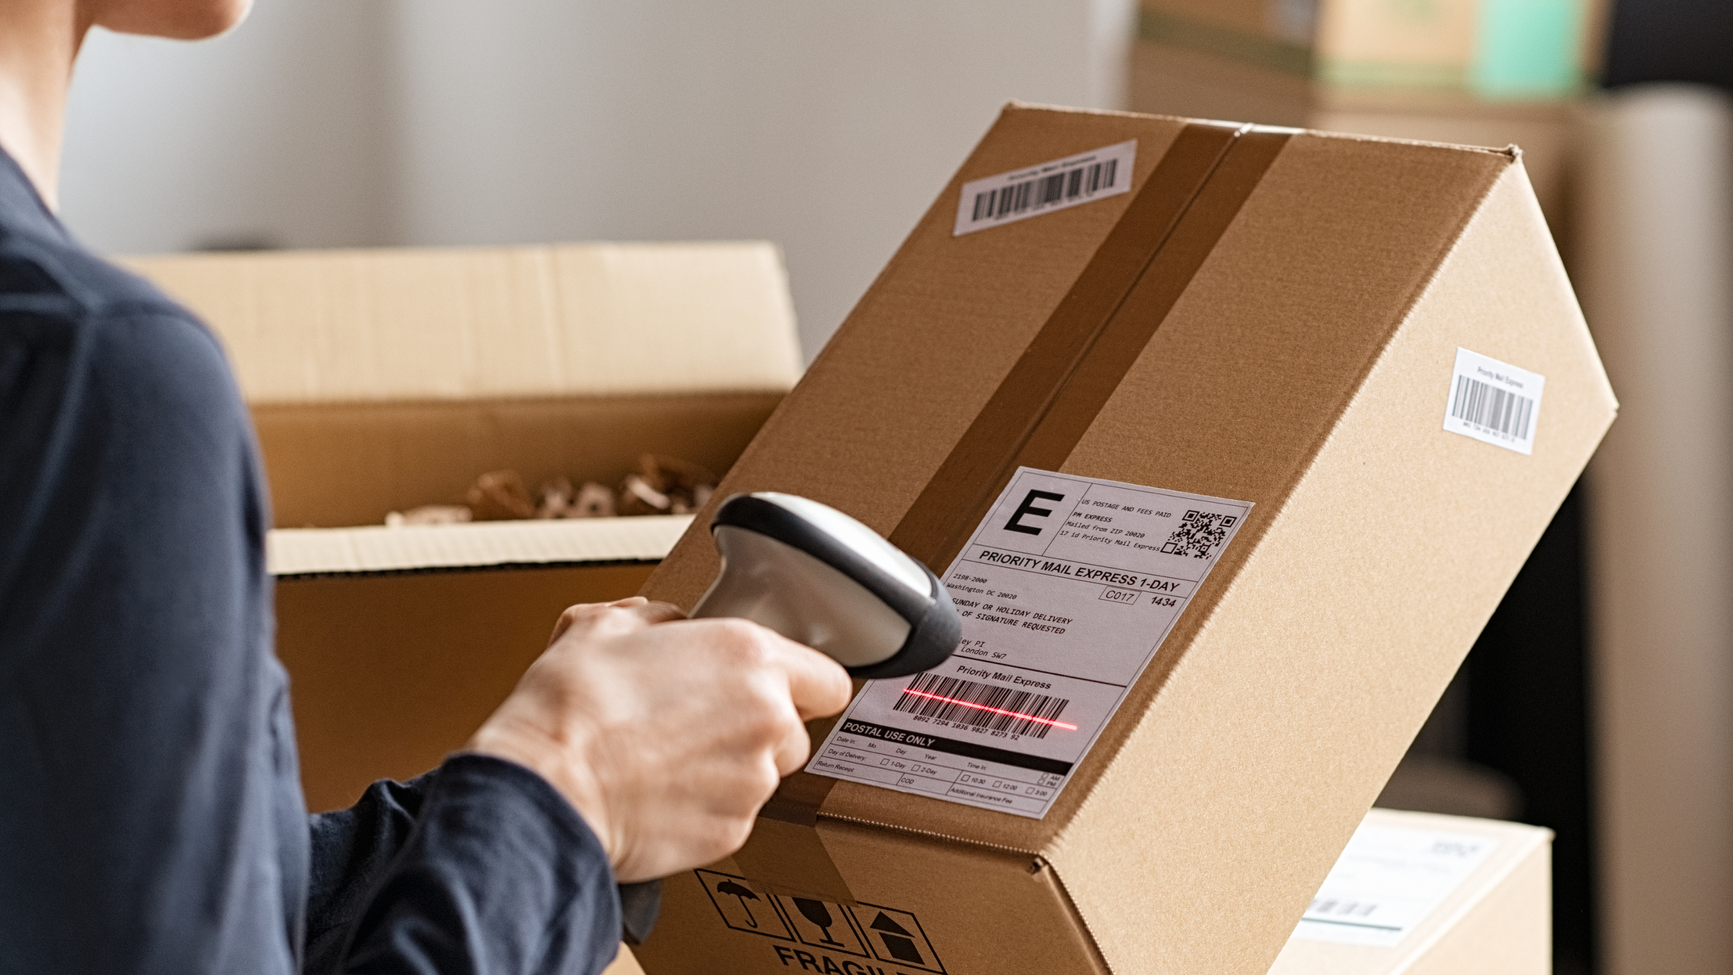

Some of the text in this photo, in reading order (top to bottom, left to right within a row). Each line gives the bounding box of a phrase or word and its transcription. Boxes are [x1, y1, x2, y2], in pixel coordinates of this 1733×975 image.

[1477, 366, 1494, 380] Priority
[1003, 489, 1065, 535] E
[1092, 500, 1119, 510] POSTAGE
[1136, 508, 1152, 516] FEES
[1083, 513, 1113, 523] EXPRESS
[1065, 520, 1090, 530] Mailed
[1125, 531, 1145, 539] 20020
[1081, 533, 1113, 545] Priority
[1114, 538, 1131, 547] Mail
[1133, 542, 1161, 552] Express
[953, 573, 988, 584] 2198-2000
[978, 550, 1181, 593] PRIORITY MAIL EXPRESS 1-DAY
[946, 583, 984, 595] Washington
[997, 591, 1018, 600] 20020
[1105, 589, 1177, 608] C017 1434
[951, 597, 980, 609] SUNDAY
[995, 606, 1031, 618] HOLIDAY
[1032, 612, 1073, 625] DELIVERY
[975, 613, 1020, 627] SIGNATURE
[1021, 621, 1066, 635] REQUESTED
[960, 645, 1007, 660] London SW7
[957, 665, 1052, 690] Priority Mail Express
[844, 722, 936, 747] POSTAL USE ONLY
[932, 719, 950, 727] 7294
[990, 730, 1008, 738] 8273
[828, 748, 838, 756] Day
[818, 760, 855, 773] Return Receipt
[890, 761, 907, 769] 1-Day
[920, 767, 938, 775] 2-Day
[951, 787, 976, 796] Additional
[976, 793, 1002, 801] Insurance
